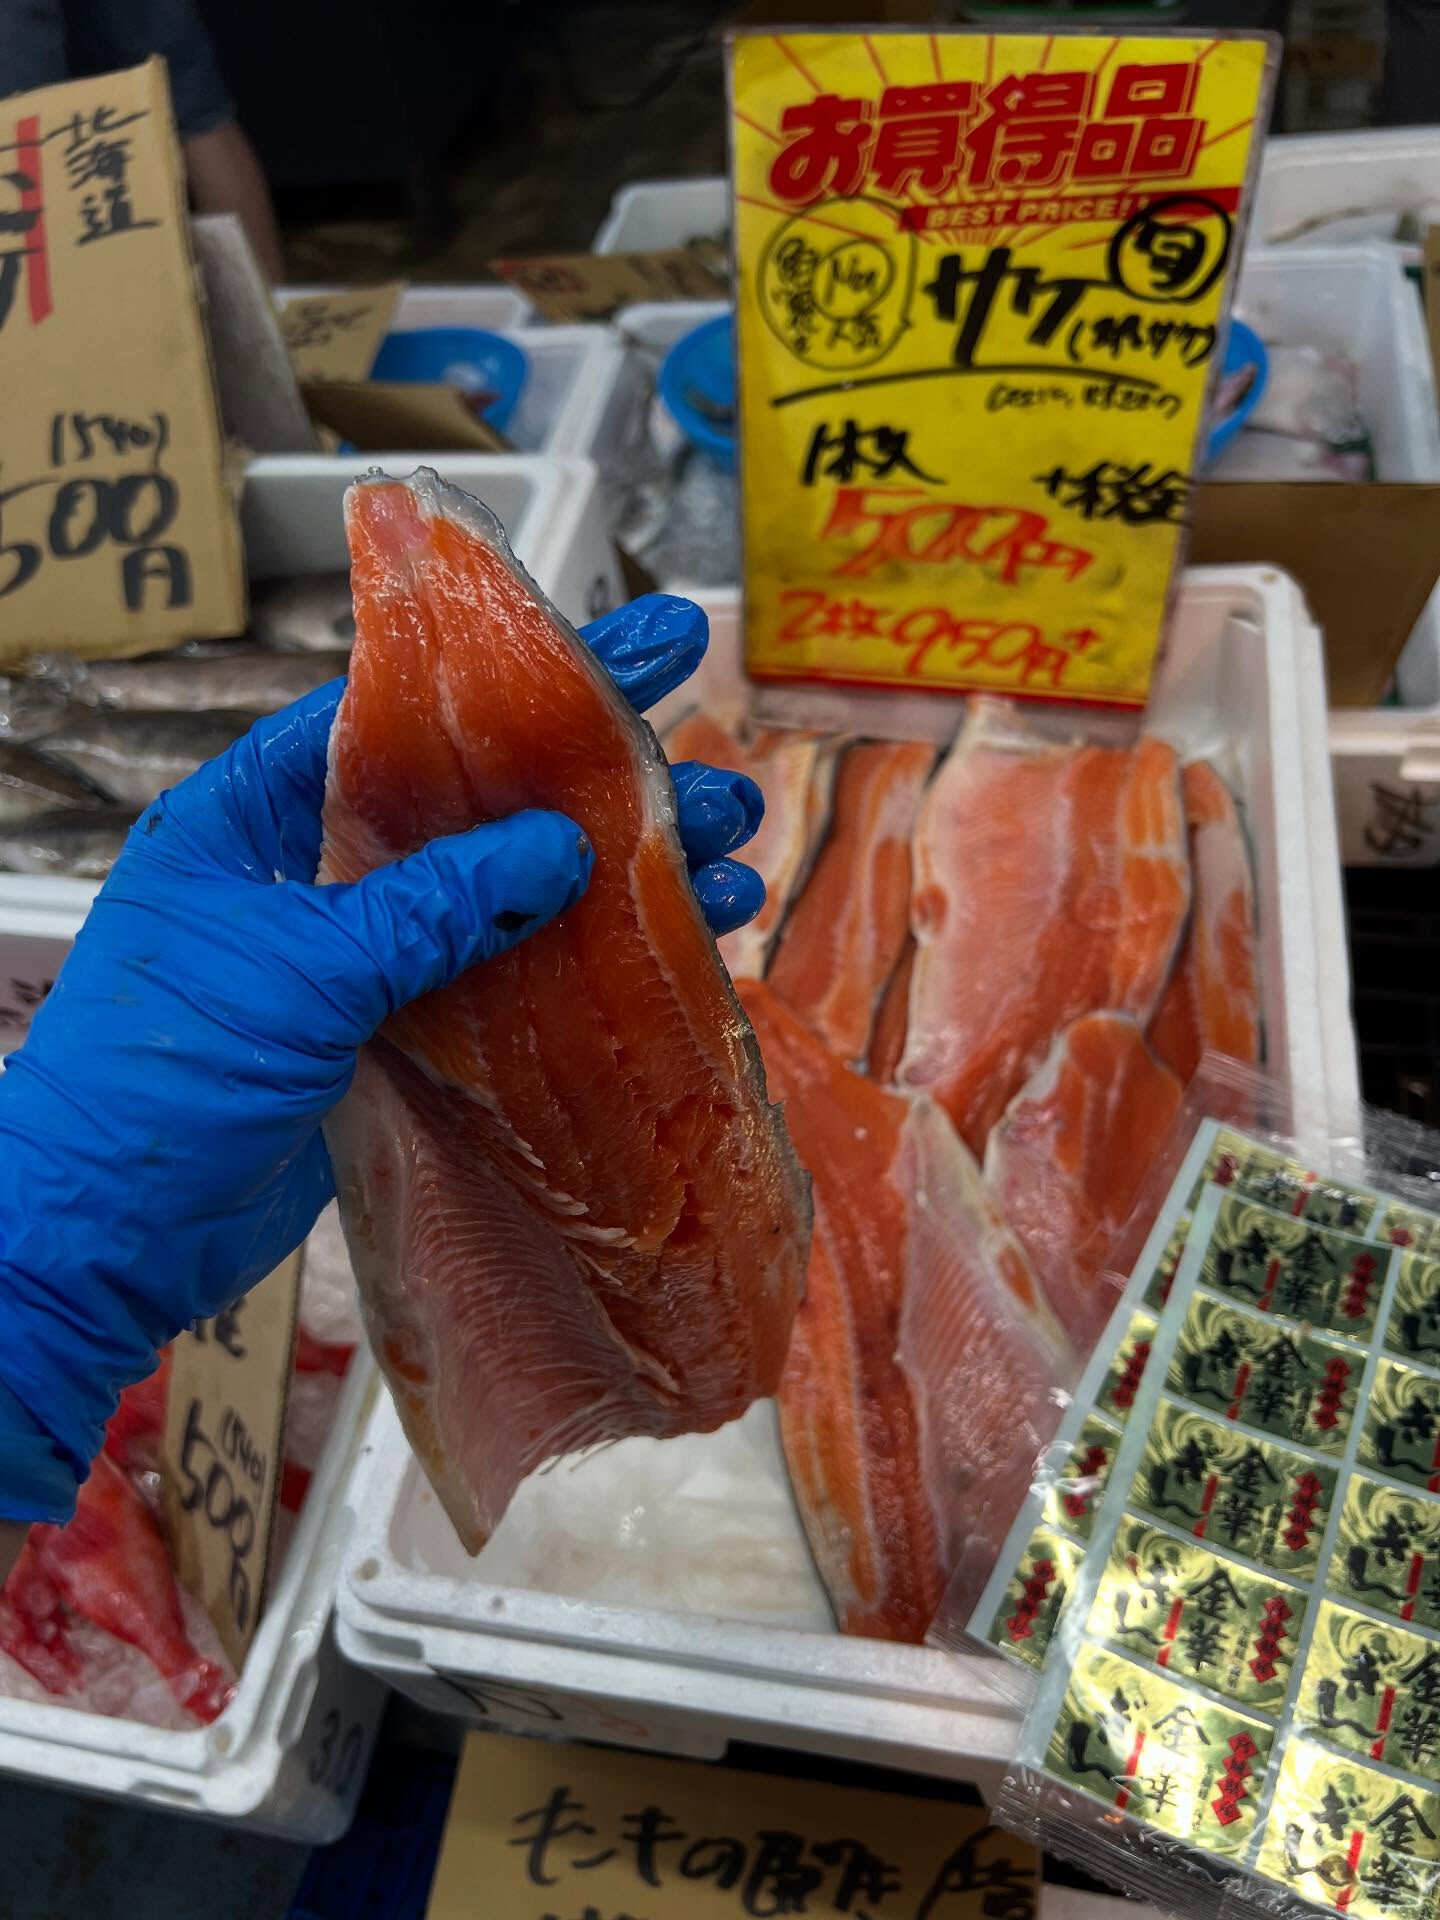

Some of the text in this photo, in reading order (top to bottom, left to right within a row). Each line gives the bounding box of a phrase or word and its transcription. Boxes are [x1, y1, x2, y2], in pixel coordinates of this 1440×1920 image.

[43, 106, 163, 247] 北海道
[768, 63, 1207, 202] お買得品
[926, 205, 1014, 229] BEST
[819, 486, 1096, 586] 500円
